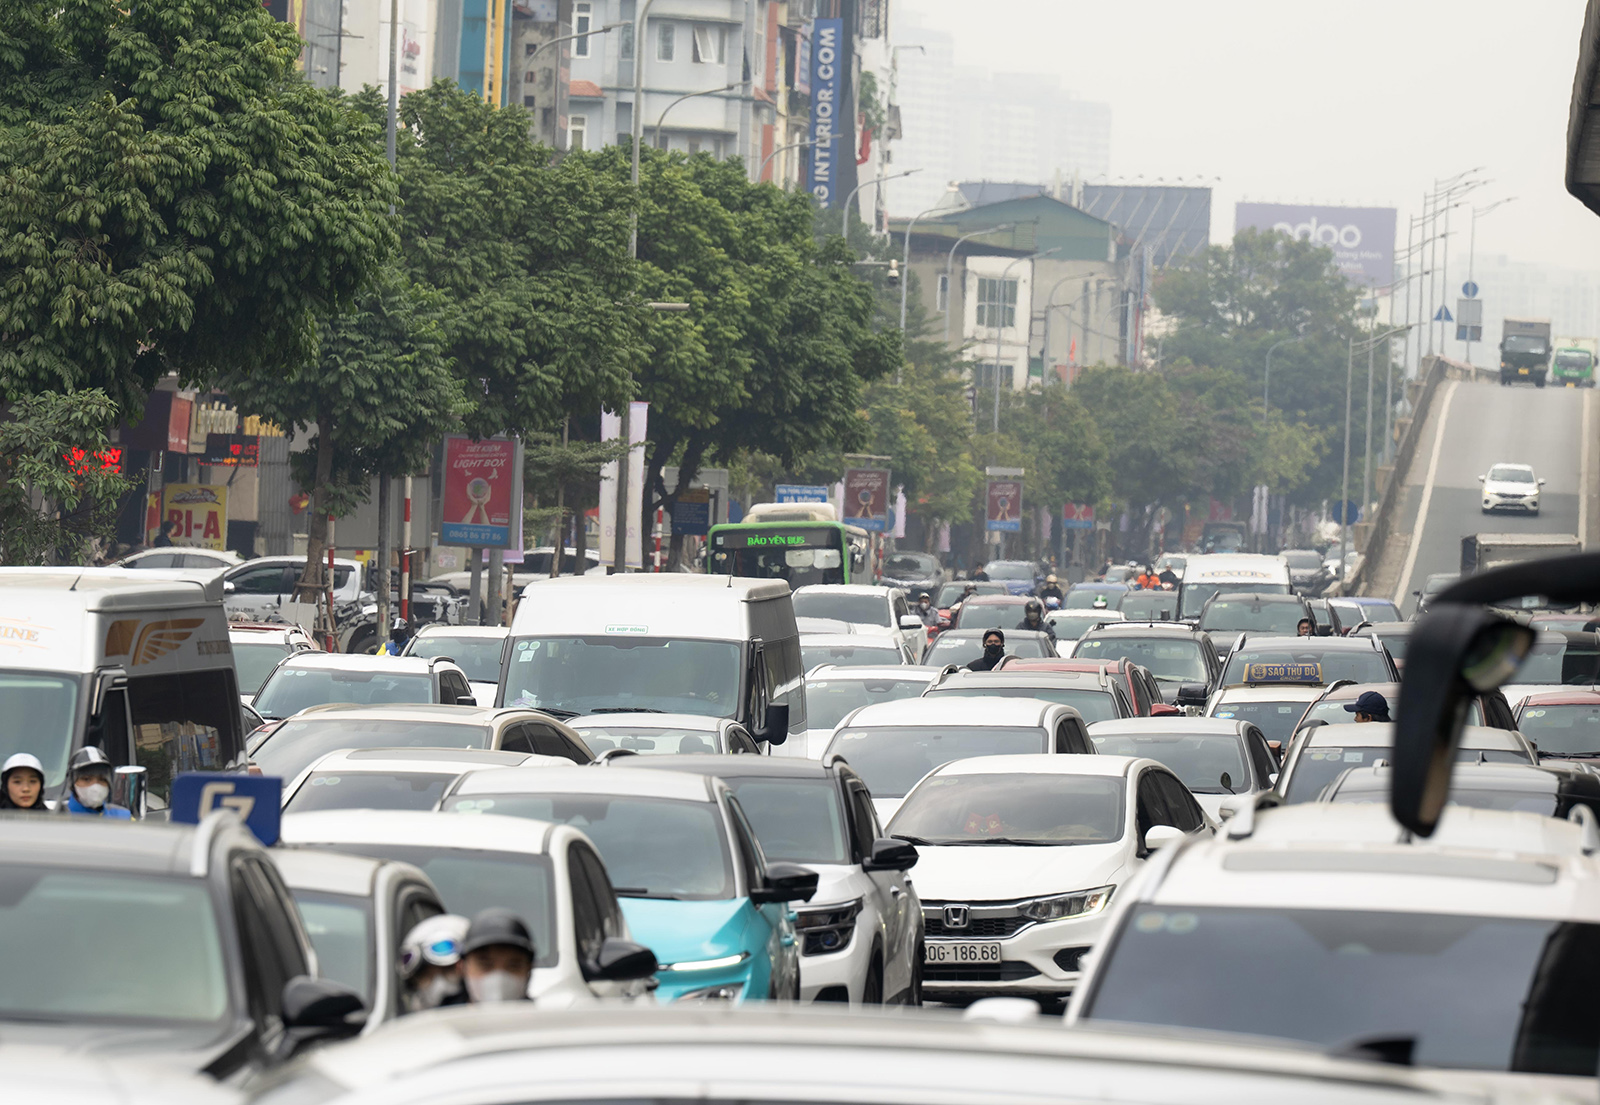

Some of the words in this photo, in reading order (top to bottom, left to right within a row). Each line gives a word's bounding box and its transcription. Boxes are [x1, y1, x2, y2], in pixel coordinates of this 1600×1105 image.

[453, 459, 484, 469] LIGHT
[483, 458, 506, 468] BOX
[168, 509, 221, 539] BI-A
[787, 535, 805, 544] BUS
[0, 625, 39, 642] INE
[1268, 667, 1285, 677] SAO
[924, 945, 998, 961] 0G-186.68
